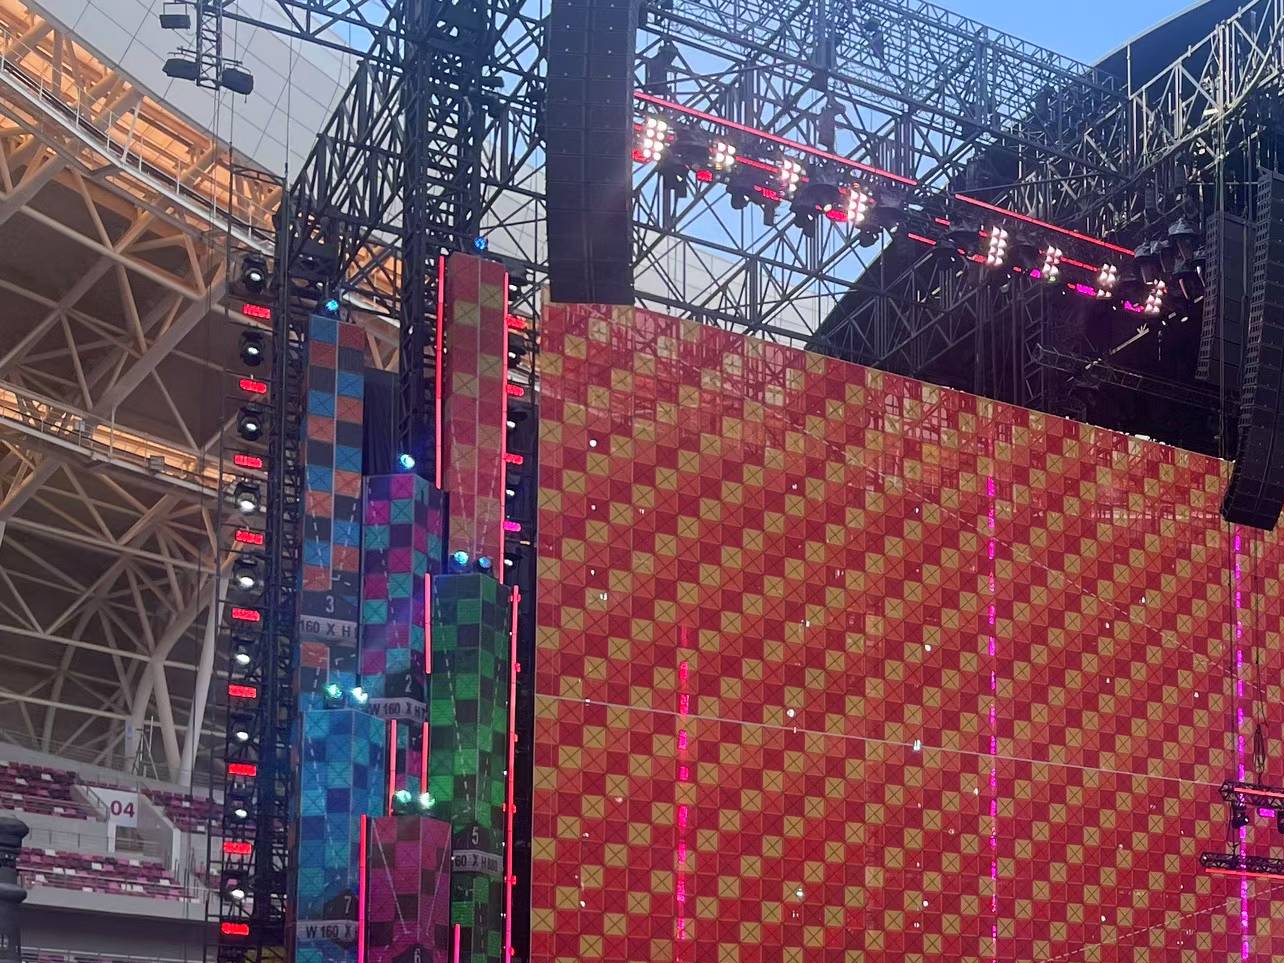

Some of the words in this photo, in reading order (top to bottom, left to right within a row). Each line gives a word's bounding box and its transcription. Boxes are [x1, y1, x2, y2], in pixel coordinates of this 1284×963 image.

[325, 595, 335, 613] 3
[405, 674, 412, 693] 2
[110, 800, 135, 818] 04
[472, 826, 479, 845] 5
[454, 854, 467, 867] 60
[344, 896, 352, 915] 7
[306, 925, 319, 939] W
[321, 925, 339, 938] 160
